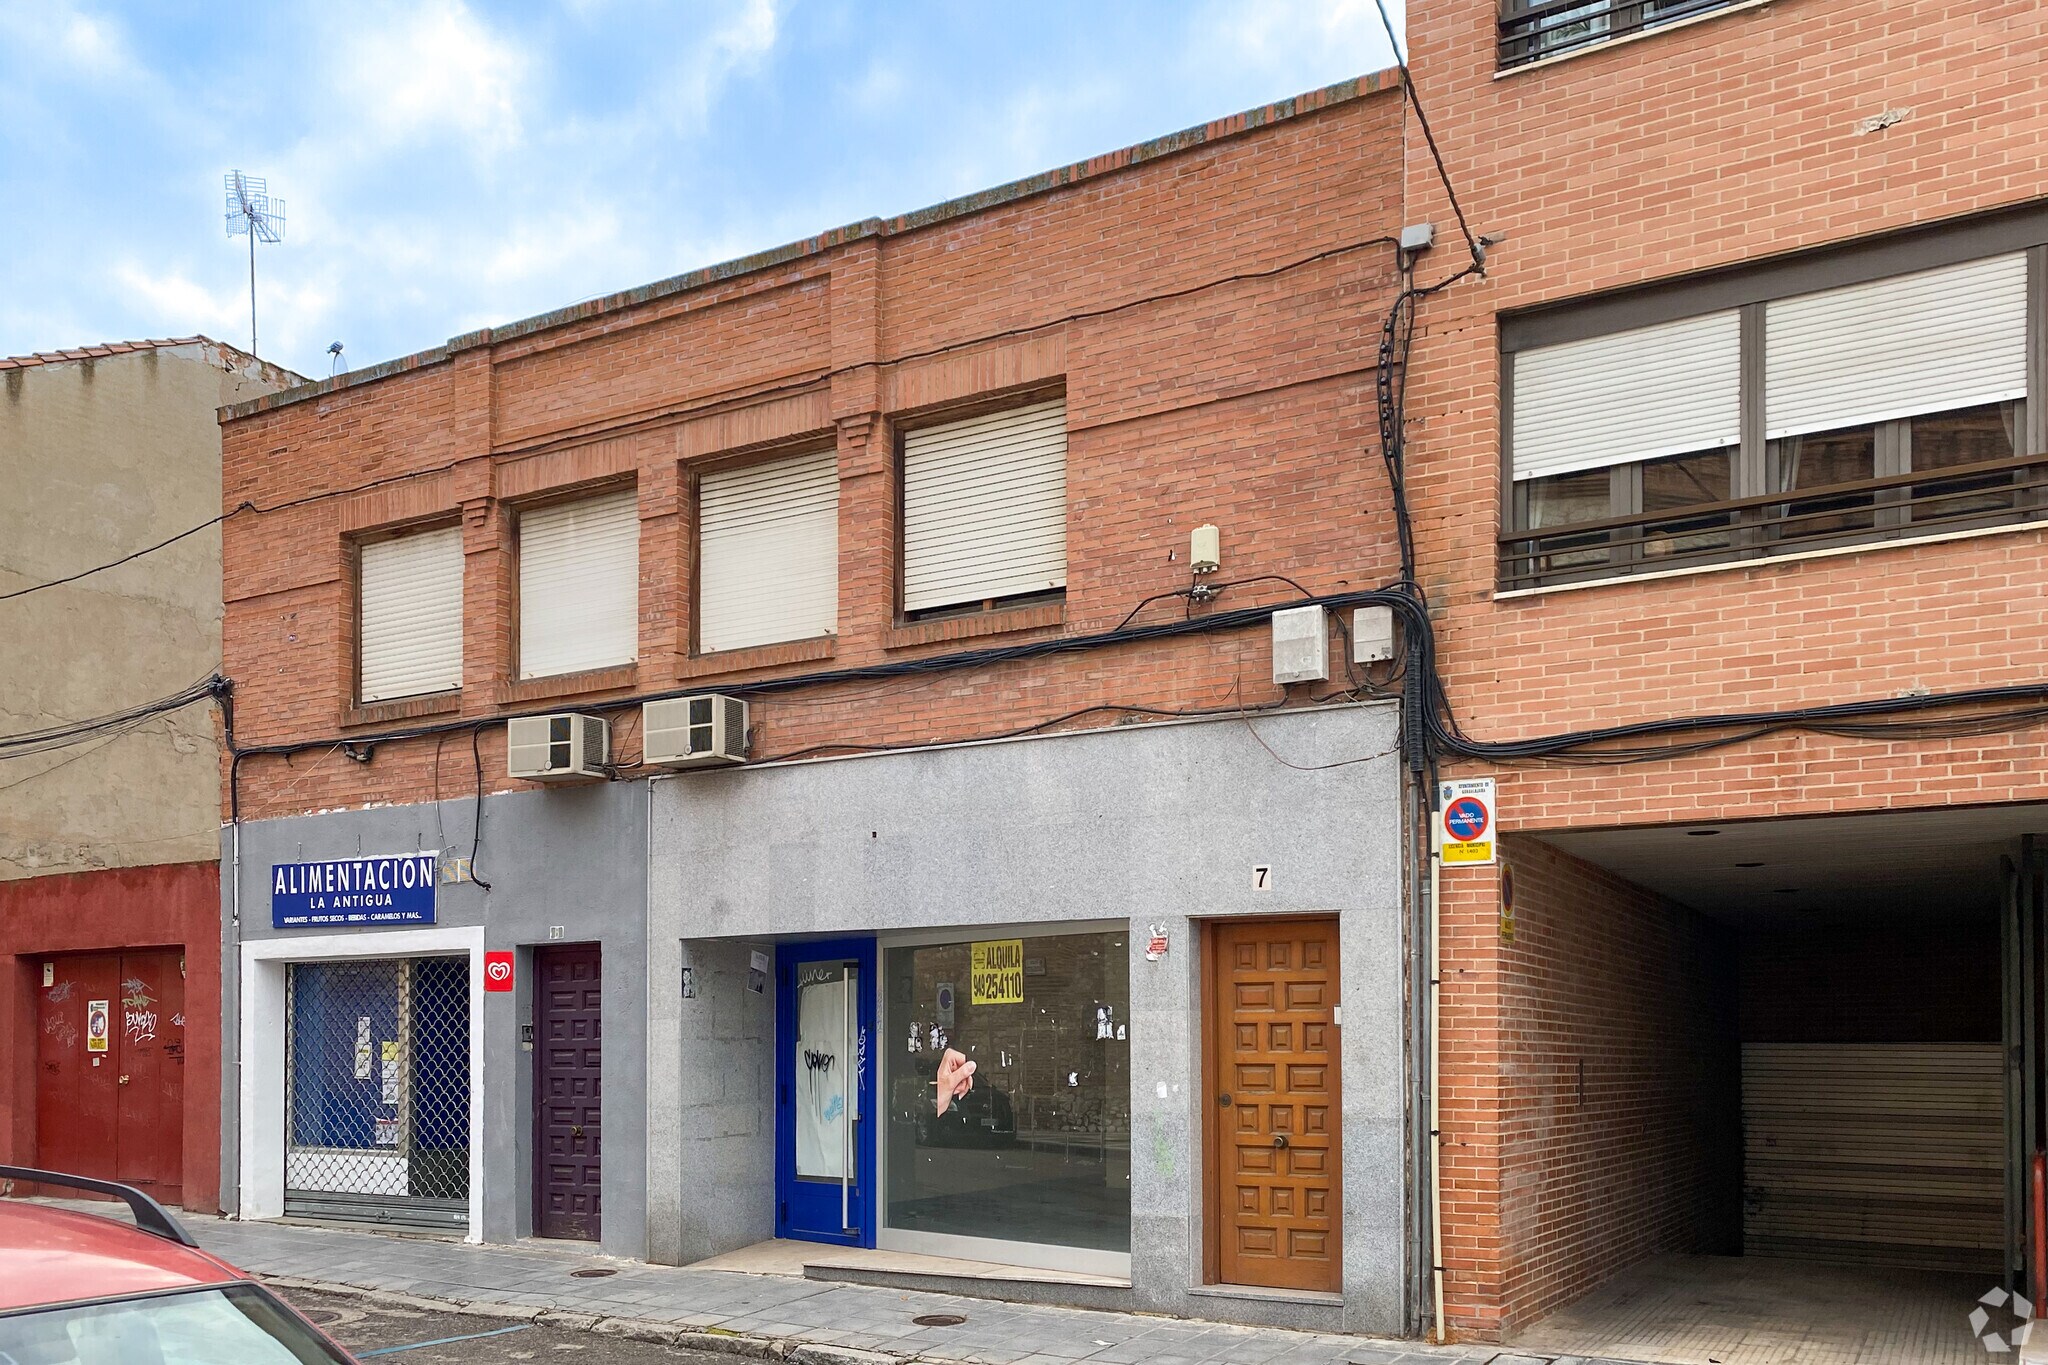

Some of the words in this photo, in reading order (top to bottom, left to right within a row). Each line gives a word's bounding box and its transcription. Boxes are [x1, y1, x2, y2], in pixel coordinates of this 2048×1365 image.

[1449, 817, 1484, 825] PERMANENTE
[275, 858, 433, 895] ALIMENTACION
[1255, 867, 1268, 888] 7
[310, 897, 325, 909] LA
[333, 893, 393, 909] ANTIGUA
[284, 916, 308, 924] VARIANTES
[311, 915, 329, 923] FRUTOS
[329, 914, 344, 922] SECOS
[348, 913, 367, 922] BEBIDAS
[370, 912, 401, 921] CARAMELOS
[402, 911, 406, 919] Y
[986, 945, 1021, 971] ALQUILA
[973, 973, 985, 997] 949
[985, 971, 1022, 999] 254110
